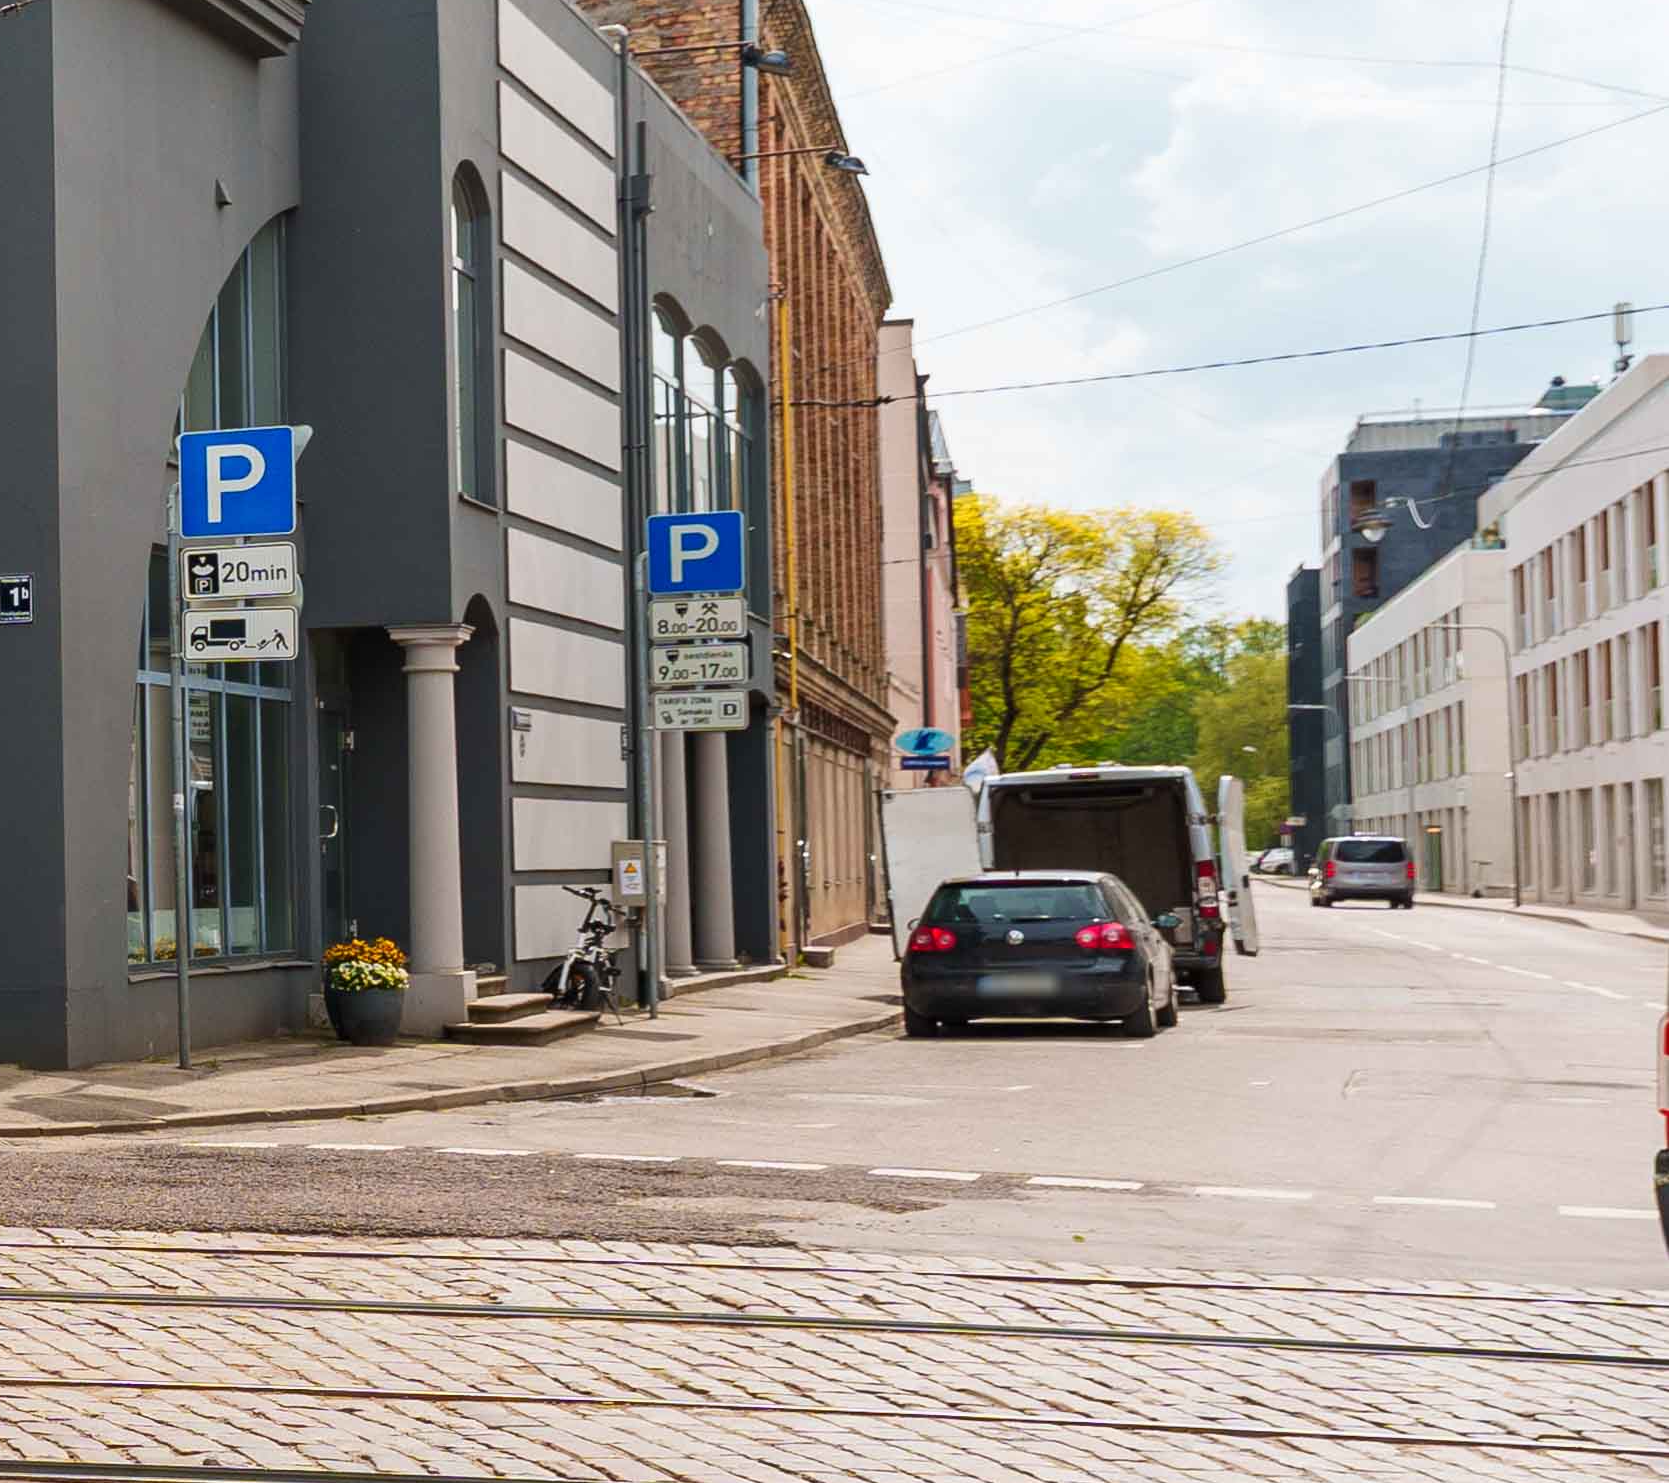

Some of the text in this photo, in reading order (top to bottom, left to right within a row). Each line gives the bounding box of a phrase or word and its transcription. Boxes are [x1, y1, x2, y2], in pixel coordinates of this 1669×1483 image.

[206, 444, 265, 523] P
[222, 561, 287, 583] 20min
[669, 524, 719, 583] P
[723, 704, 736, 716] D
